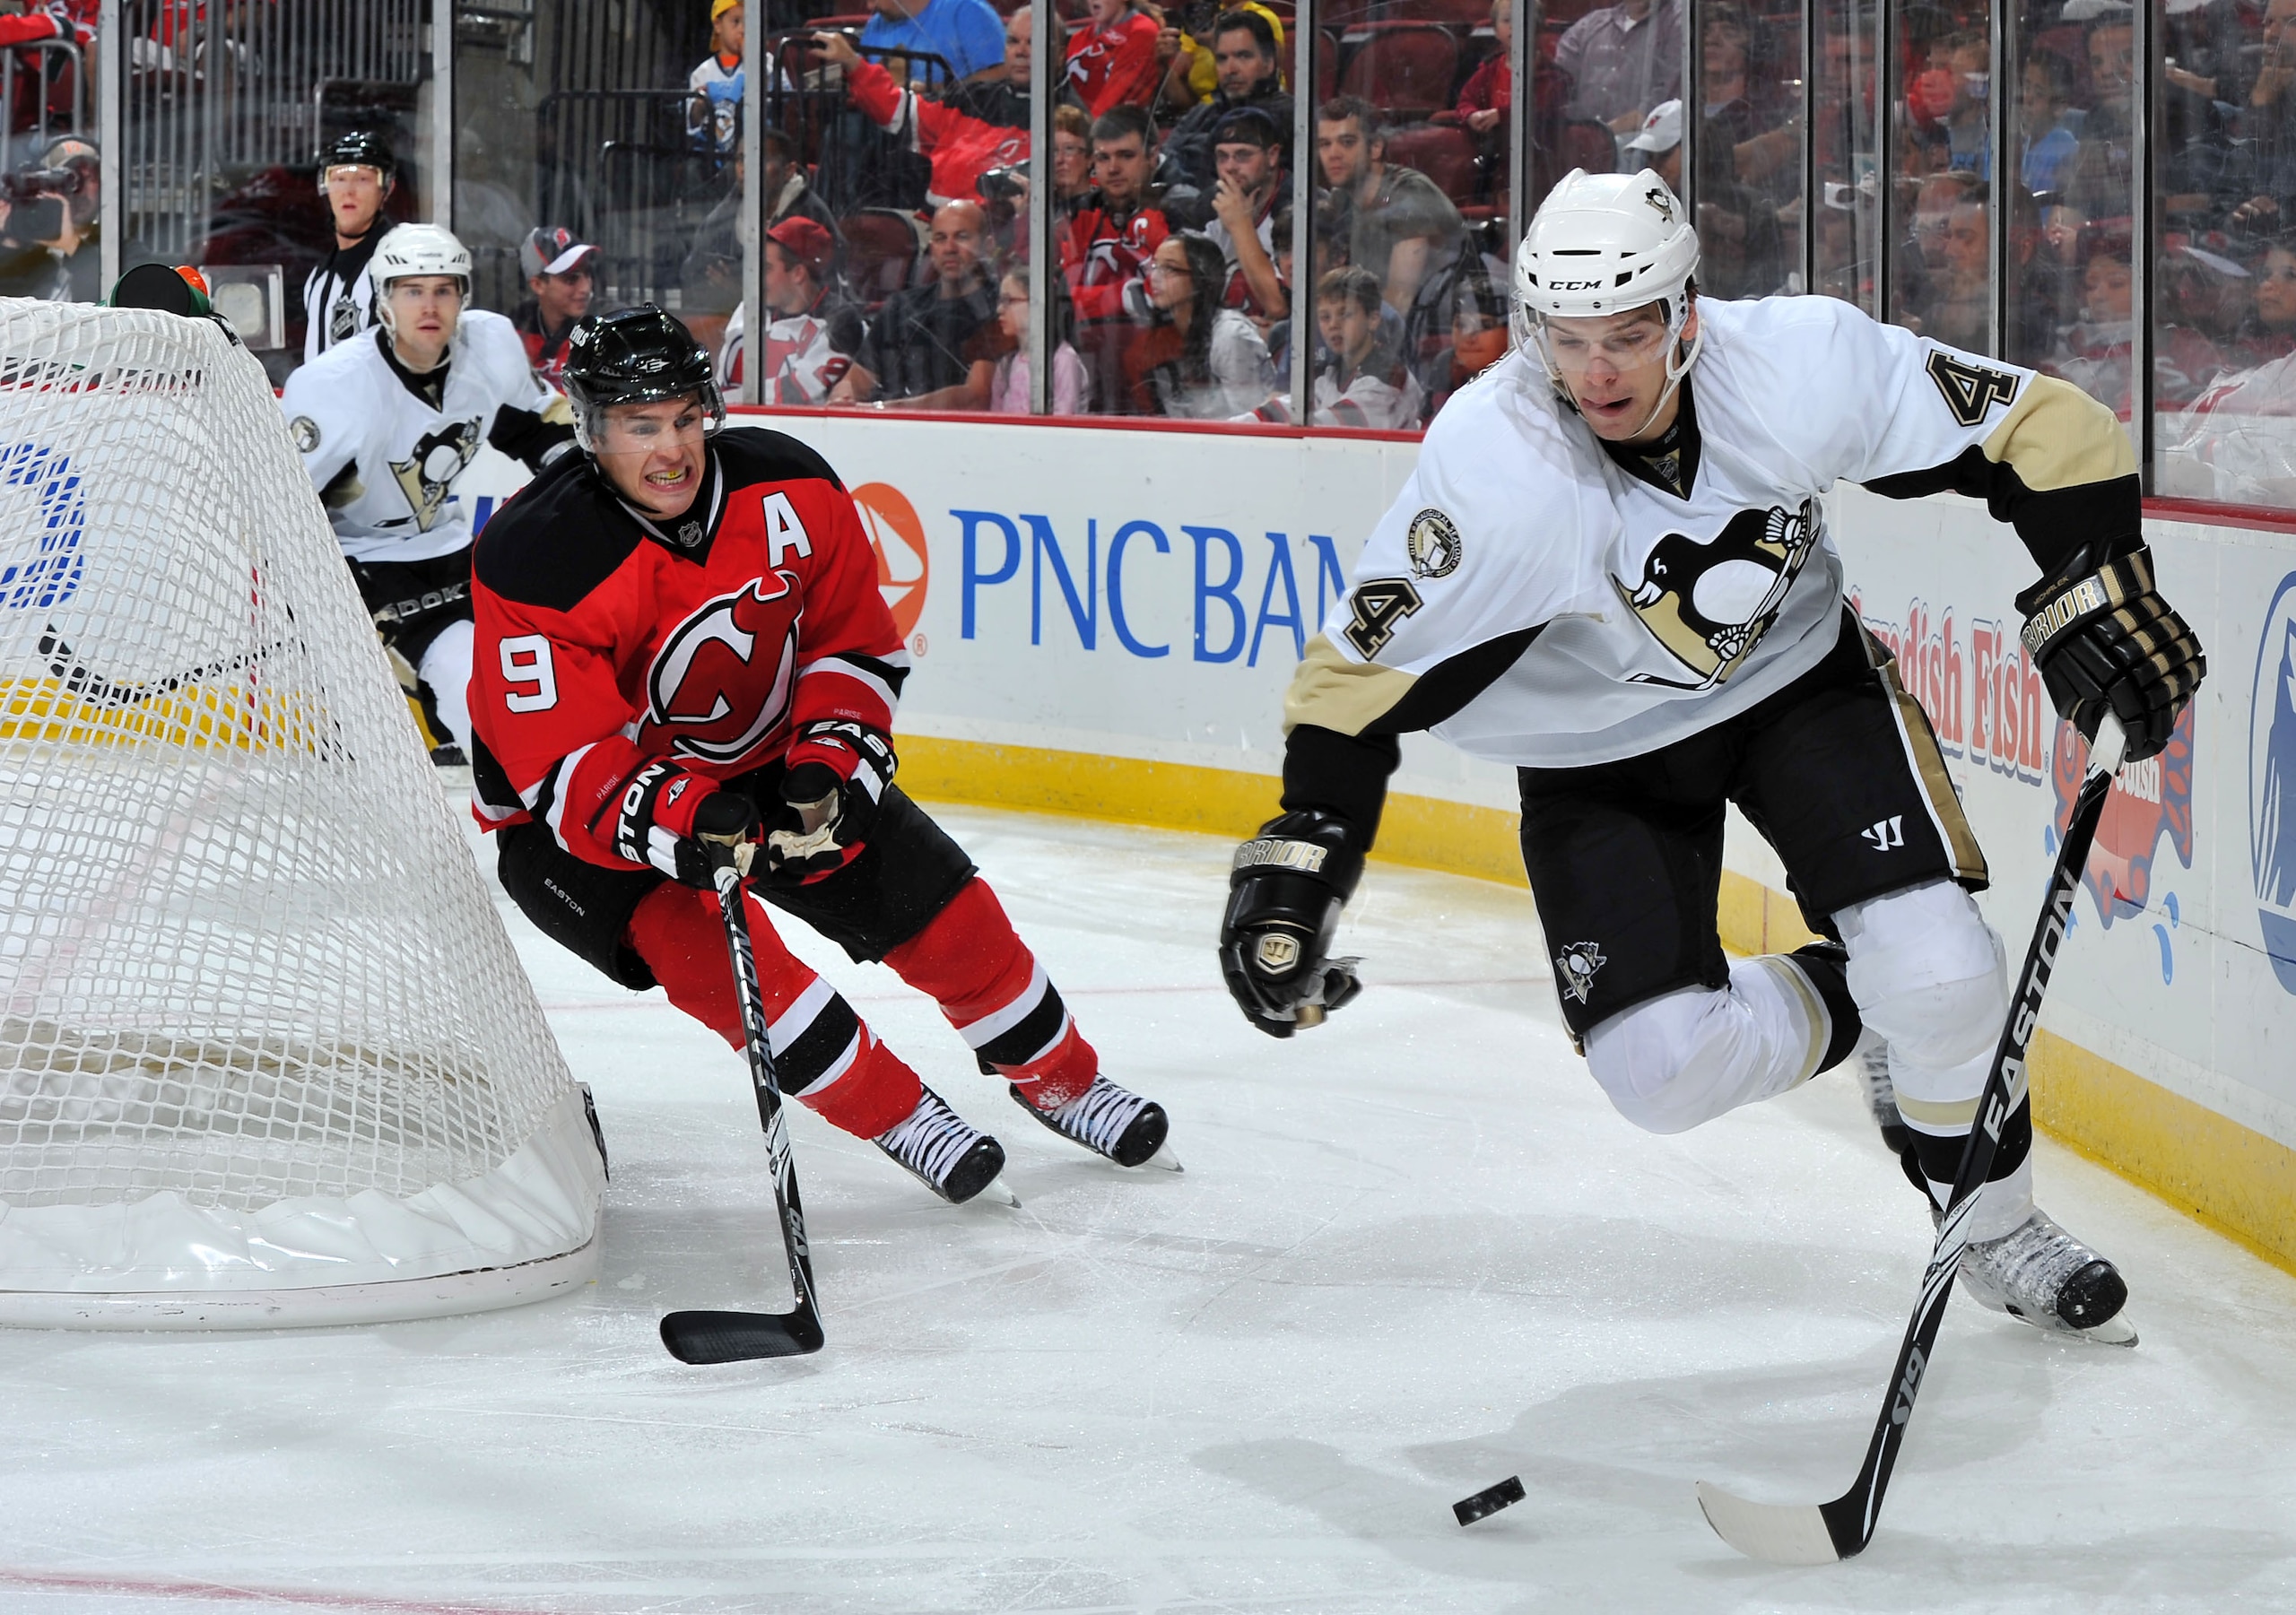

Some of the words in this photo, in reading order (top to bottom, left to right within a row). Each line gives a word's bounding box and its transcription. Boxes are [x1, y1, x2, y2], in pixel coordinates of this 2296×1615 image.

[1548, 280, 1603, 291] CCM
[1925, 348, 2021, 428] 4
[761, 490, 813, 569] A
[949, 509, 1170, 659] PNC
[1180, 525, 1352, 668] BAN
[1343, 577, 1425, 663] 4
[2021, 581, 2100, 659] RRIOR
[498, 632, 559, 714] 9
[1970, 621, 2043, 785] Fish
[808, 721, 896, 777] EAST
[833, 708, 862, 720] PARISE
[596, 774, 621, 800] PARISE
[618, 763, 665, 864] STON
[1234, 840, 1328, 873] RRIOR
[544, 877, 586, 916] EASTON
[1982, 864, 2080, 1144] EASTON
[1892, 1346, 1926, 1427] S19
